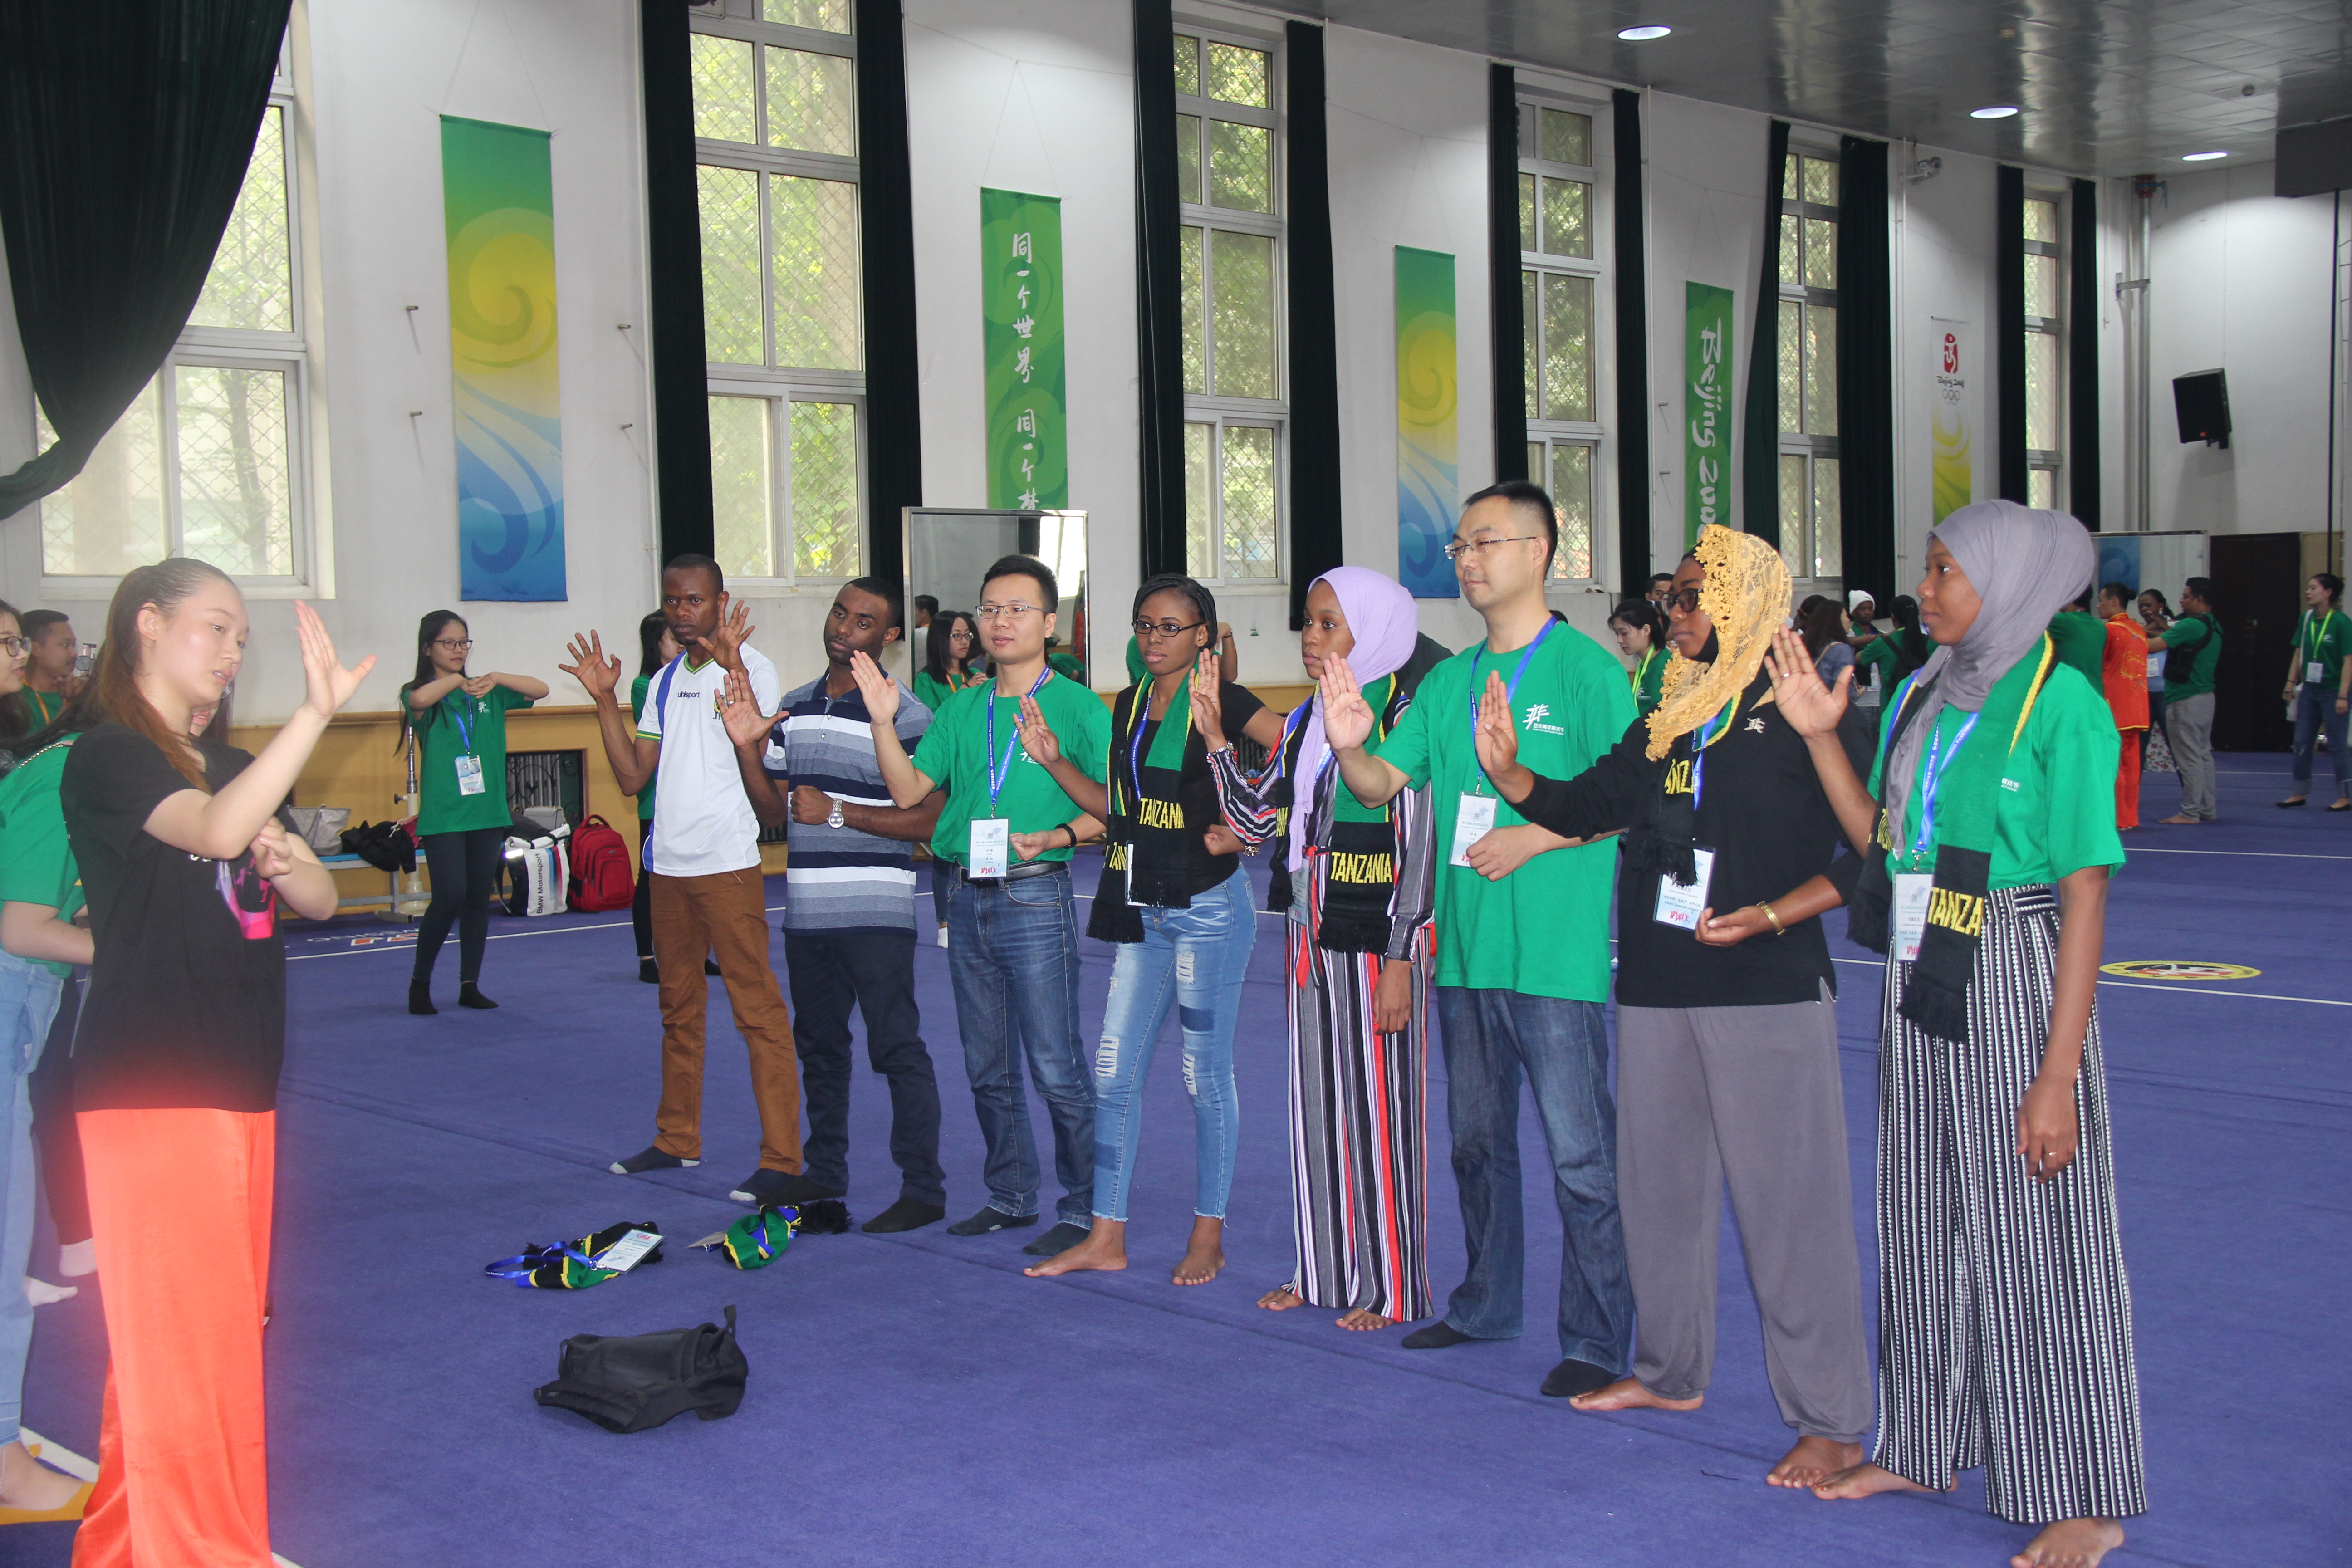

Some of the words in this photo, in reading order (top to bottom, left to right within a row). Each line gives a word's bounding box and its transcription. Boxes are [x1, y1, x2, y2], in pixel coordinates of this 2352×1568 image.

[1012, 232, 1035, 384] 同一个世界
[1692, 317, 1722, 448] Beijing
[677, 691, 700, 699] uhlsport
[535, 853, 544, 894] Motorsport
[1330, 851, 1393, 884] TANZANIA
[1927, 886, 1984, 937] TANZA
